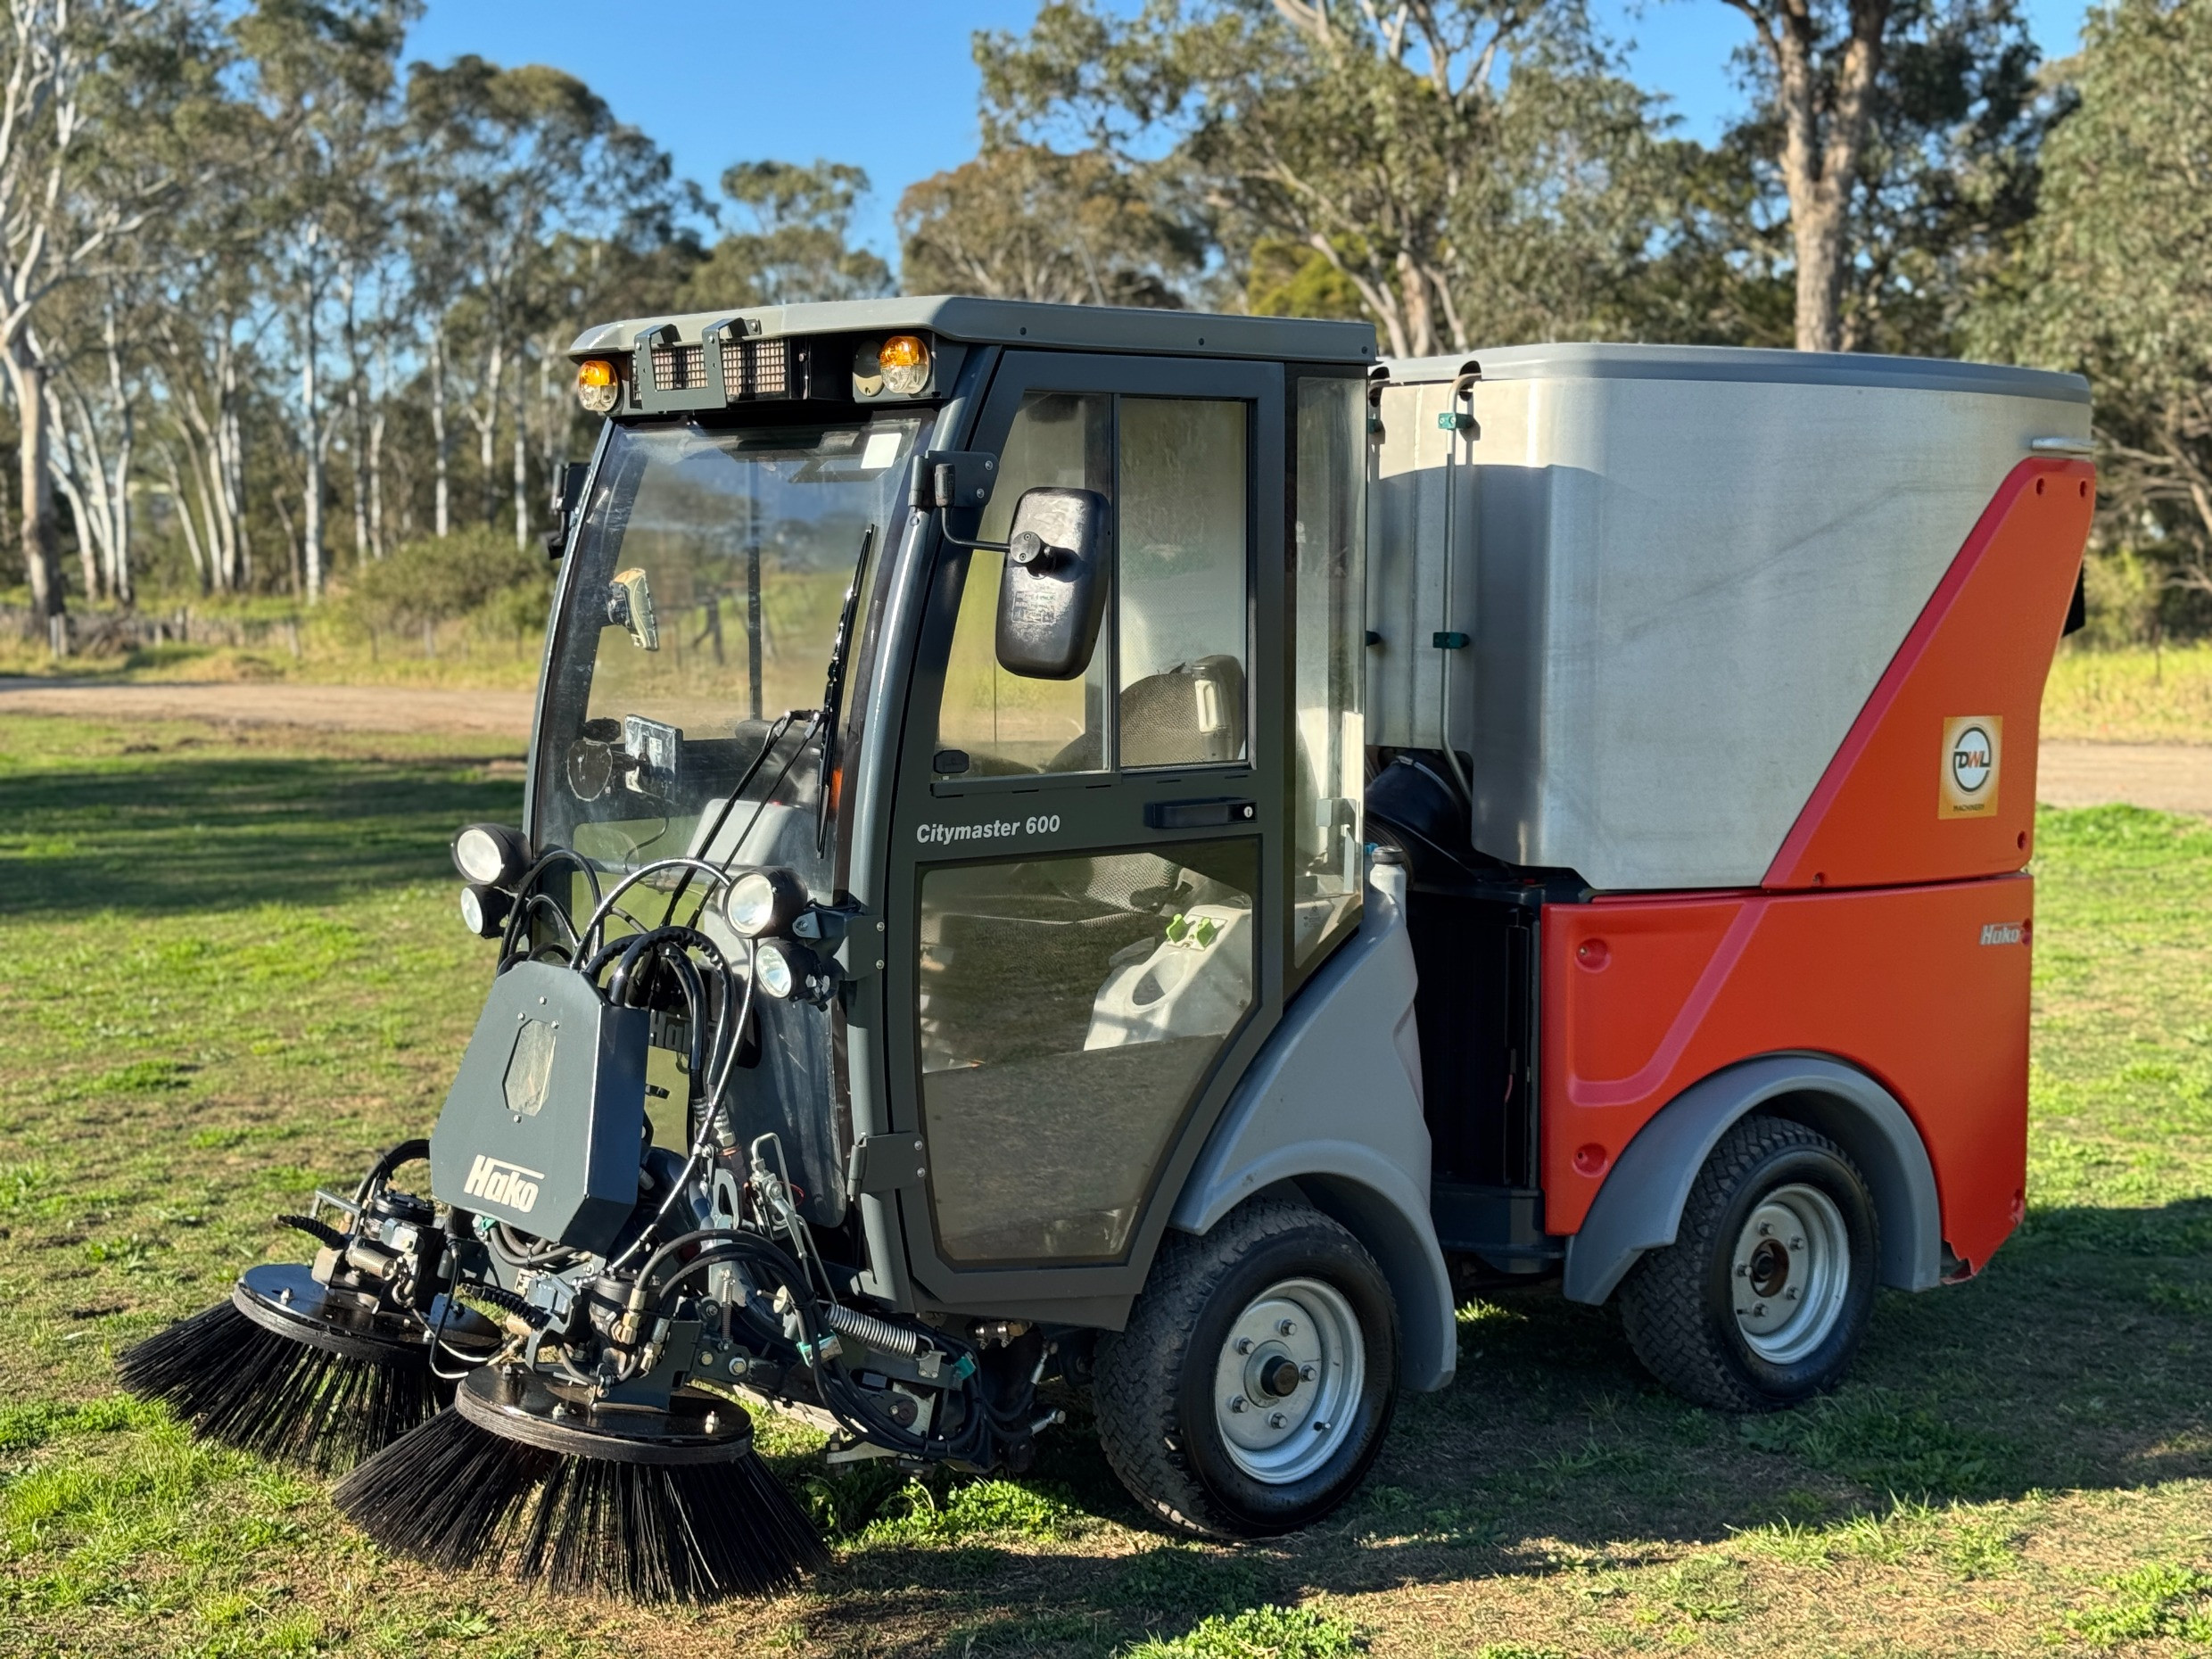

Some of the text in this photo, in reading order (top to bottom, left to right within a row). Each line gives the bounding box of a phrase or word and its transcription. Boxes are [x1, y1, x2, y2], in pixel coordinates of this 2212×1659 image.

[916, 814, 1061, 845] Citymaster 600
[1981, 921, 2021, 945] Hako
[464, 1154, 545, 1213] Hako
